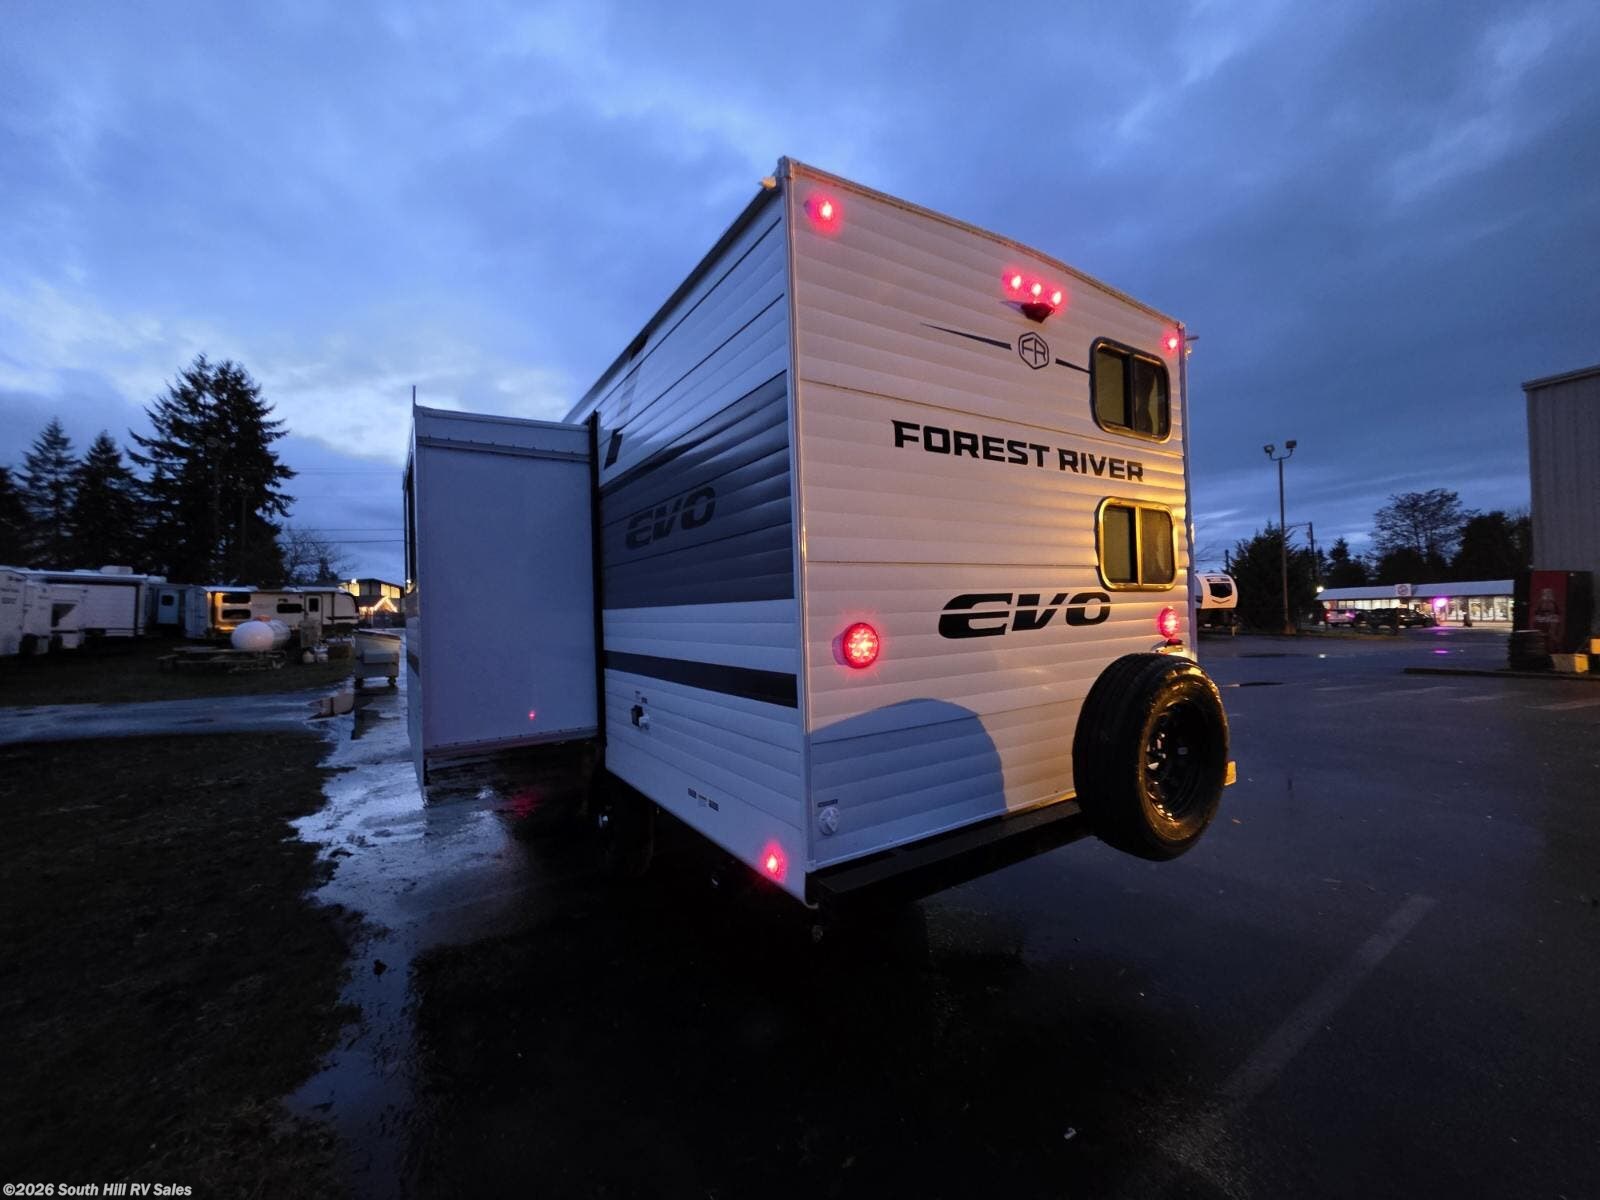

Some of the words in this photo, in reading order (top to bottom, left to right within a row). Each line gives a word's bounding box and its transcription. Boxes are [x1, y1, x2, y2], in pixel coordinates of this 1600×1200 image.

[891, 419, 1050, 468] FOREST
[1056, 447, 1144, 482] RIVER
[625, 486, 716, 550] EVO
[938, 591, 1111, 639] EVO
